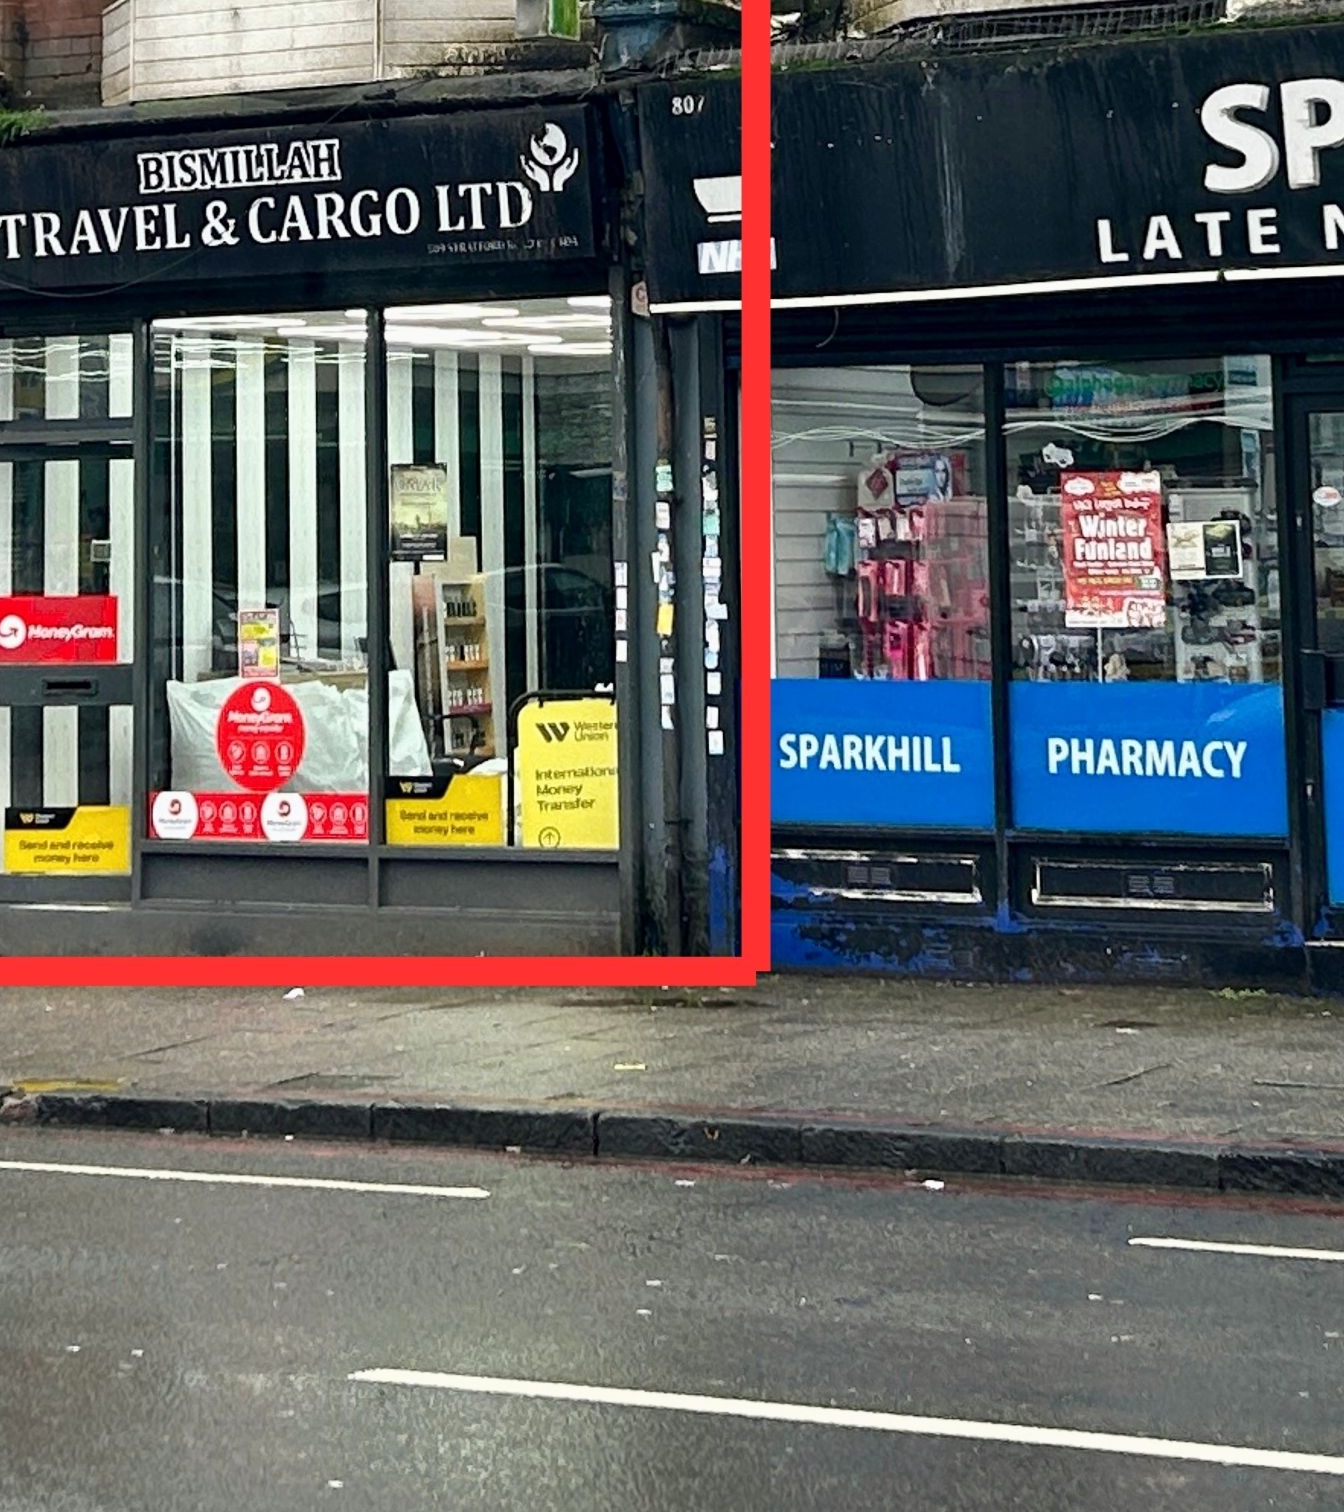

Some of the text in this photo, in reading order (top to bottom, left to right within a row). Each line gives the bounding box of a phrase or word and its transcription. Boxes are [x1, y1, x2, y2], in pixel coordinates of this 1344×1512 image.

[671, 95, 705, 115] 807
[137, 139, 342, 194] BISMILLAH
[201, 202, 240, 245] &
[248, 186, 421, 243] CARGO
[436, 179, 533, 233] LTD
[1097, 206, 1281, 265] LATE
[1078, 512, 1147, 539] Winter
[1074, 537, 1153, 561] Funland
[27, 624, 115, 642] MoneyGram
[574, 731, 609, 743] Union
[779, 734, 961, 774] SPARKHILL
[1047, 737, 1246, 778] PHARMACY
[536, 784, 583, 796] Money
[537, 798, 595, 812] Transfer
